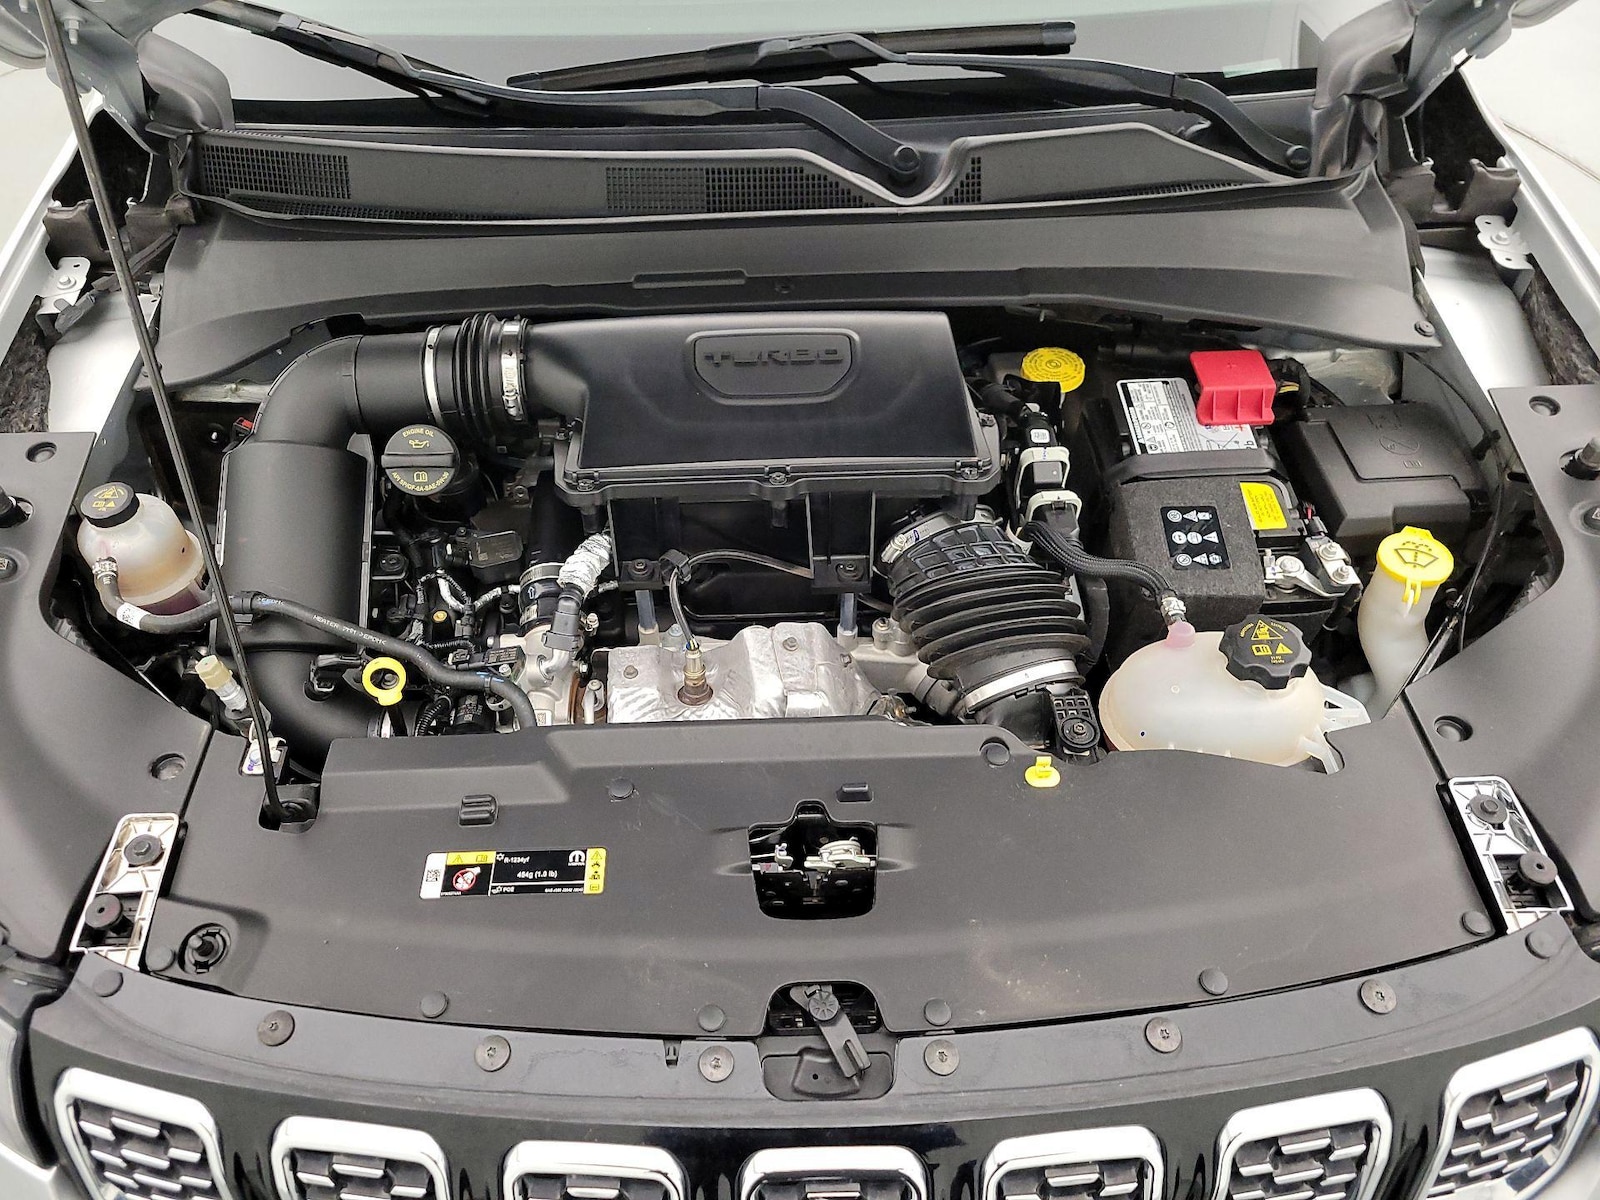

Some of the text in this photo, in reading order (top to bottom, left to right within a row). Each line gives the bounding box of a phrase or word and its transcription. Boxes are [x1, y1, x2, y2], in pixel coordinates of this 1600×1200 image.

[703, 349, 844, 367] TURBO
[402, 427, 434, 438] ENGINE OIL
[503, 855, 530, 864] R-1234yf
[516, 870, 534, 879] 454g
[548, 870, 558, 879] lb)
